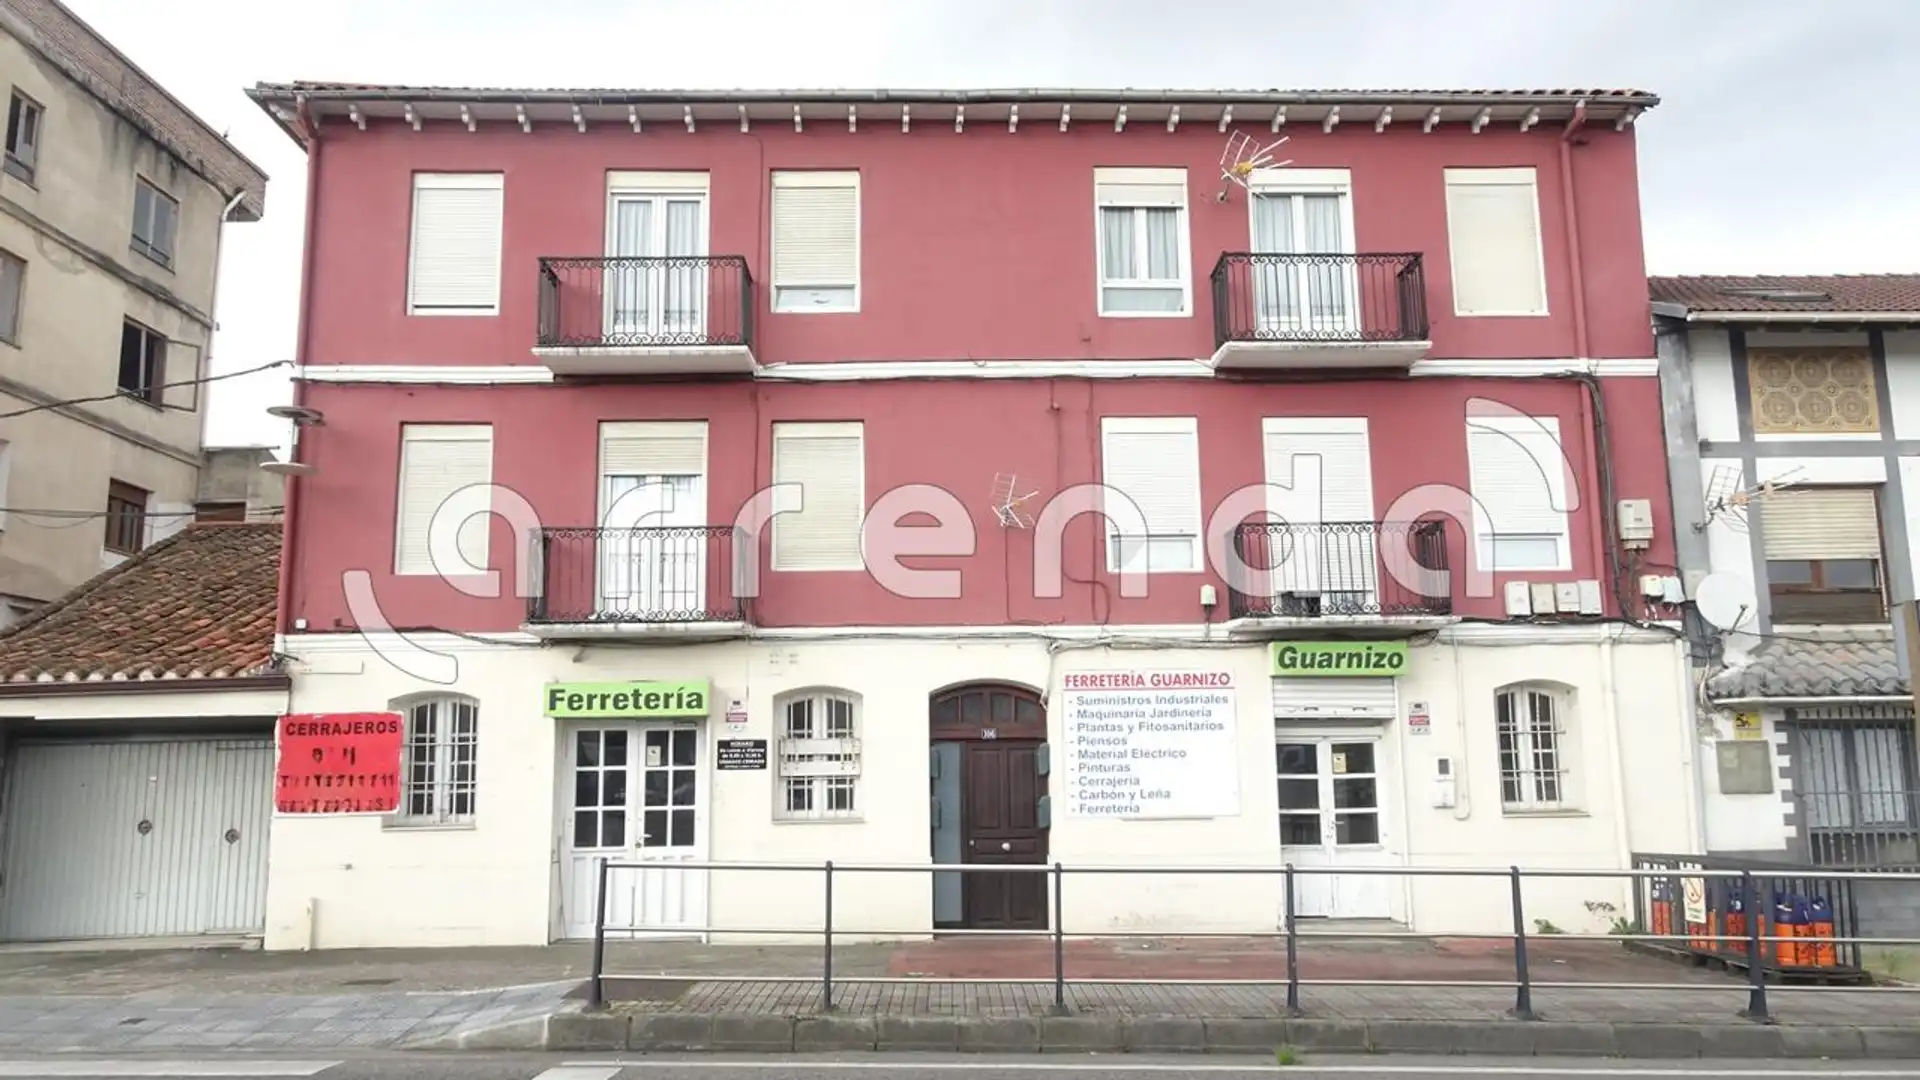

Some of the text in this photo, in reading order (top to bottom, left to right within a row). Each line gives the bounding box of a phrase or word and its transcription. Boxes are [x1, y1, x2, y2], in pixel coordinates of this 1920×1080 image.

[1278, 645, 1403, 669] Guarnizo
[1064, 669, 1231, 688] FERRETERÍA GUARNIZO
[548, 686, 703, 711] Ferretería
[1076, 694, 1229, 706] Suministros Industriales
[1076, 708, 1146, 720] Maquinaria
[285, 721, 398, 736] CERRAJEROS
[1077, 720, 1225, 735] Plantas y Fitosanitarios
[1077, 736, 1128, 746] Piensos
[1078, 749, 1128, 760] Material
[1078, 762, 1131, 773] Pinturas
[1130, 791, 1136, 801] y
[1140, 788, 1171, 800] Leña
